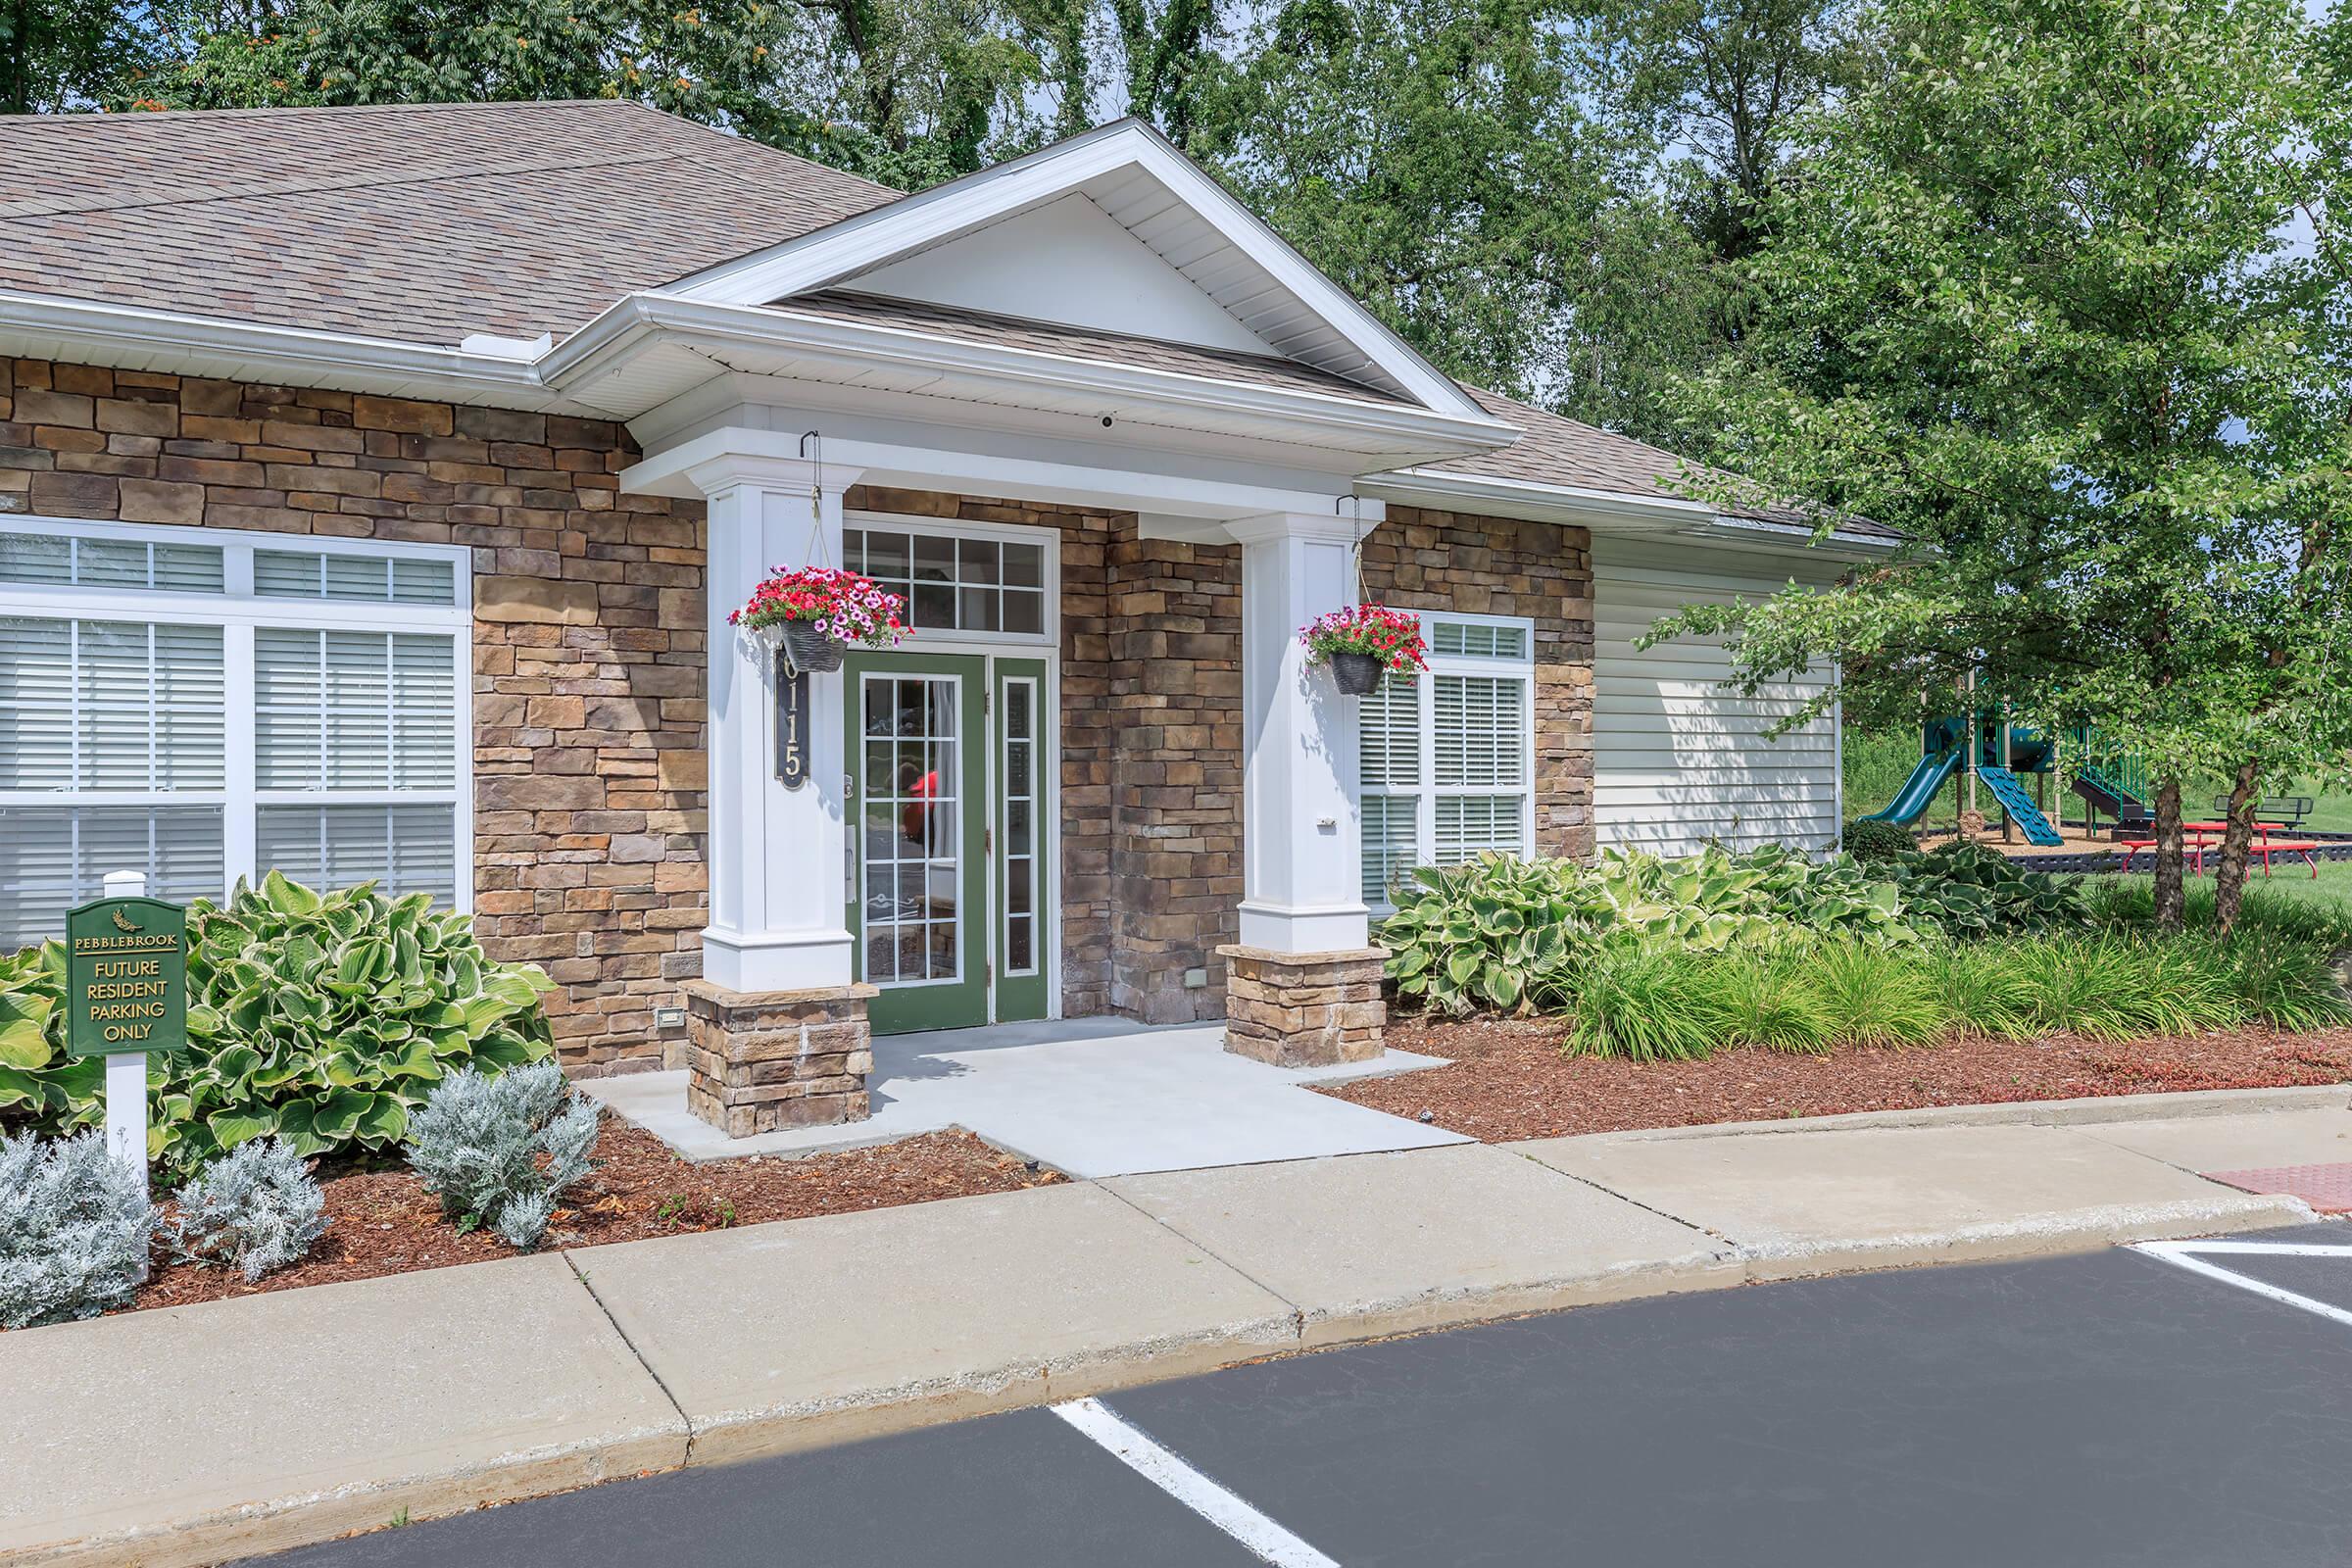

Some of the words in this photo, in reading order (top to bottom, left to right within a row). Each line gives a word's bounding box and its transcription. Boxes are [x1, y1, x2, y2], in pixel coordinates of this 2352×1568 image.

[75, 935, 177, 949] PEBBLEBROOK
[95, 960, 159, 977] FUTURE
[87, 981, 168, 999] RESIDENT
[90, 1003, 165, 1020] PARKING
[104, 1024, 152, 1041] ONLY
